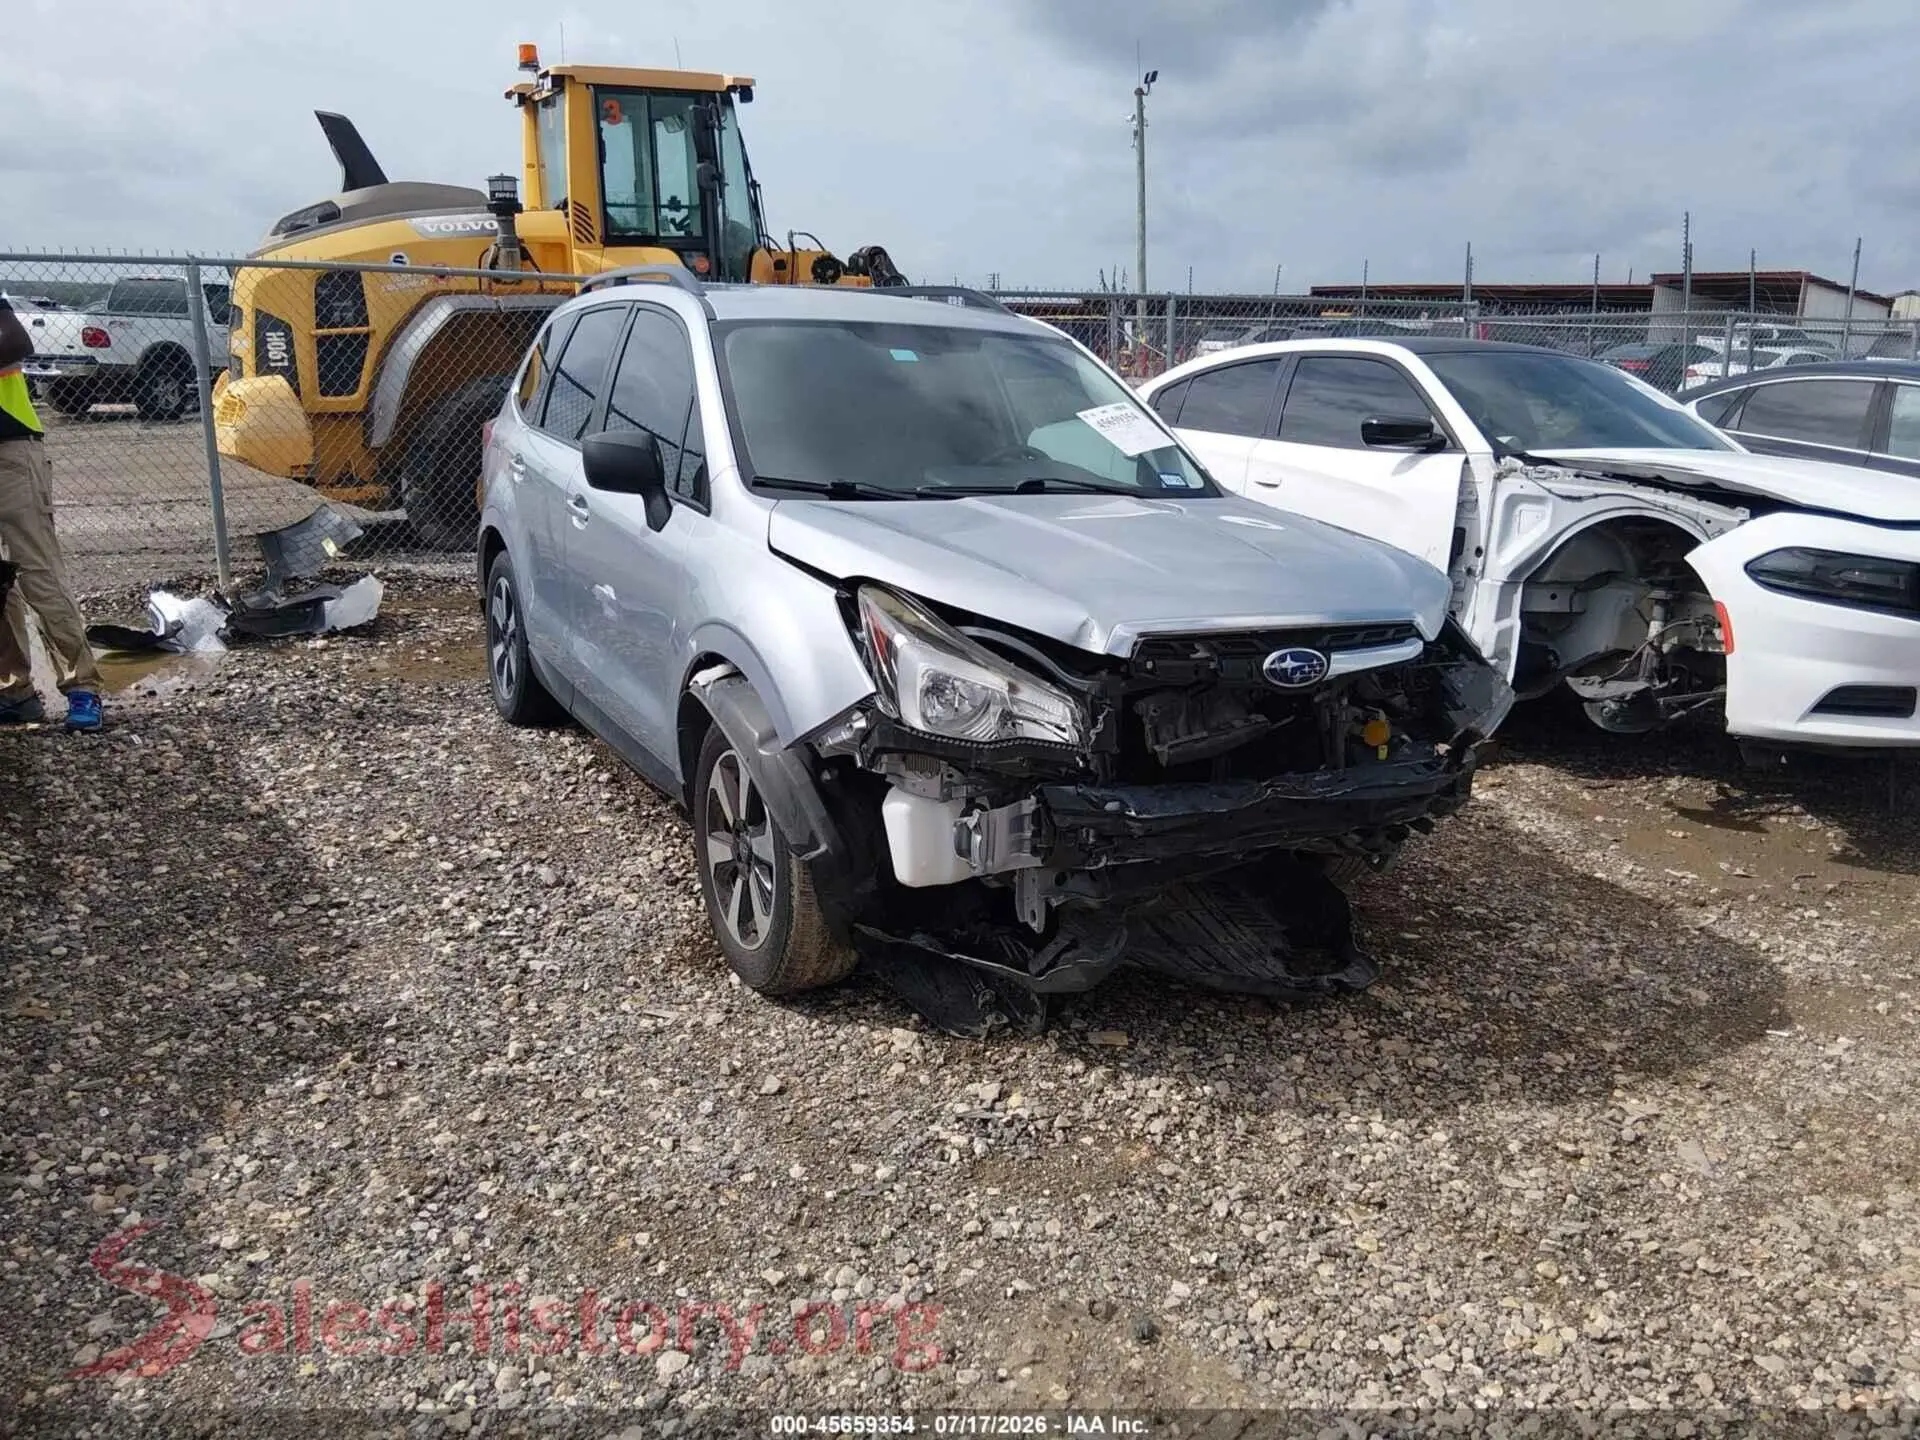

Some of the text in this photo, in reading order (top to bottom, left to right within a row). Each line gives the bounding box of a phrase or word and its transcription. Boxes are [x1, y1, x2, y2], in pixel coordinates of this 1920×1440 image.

[602, 99, 623, 126] 3
[423, 220, 499, 233] VOLVO
[265, 331, 289, 367] L90H
